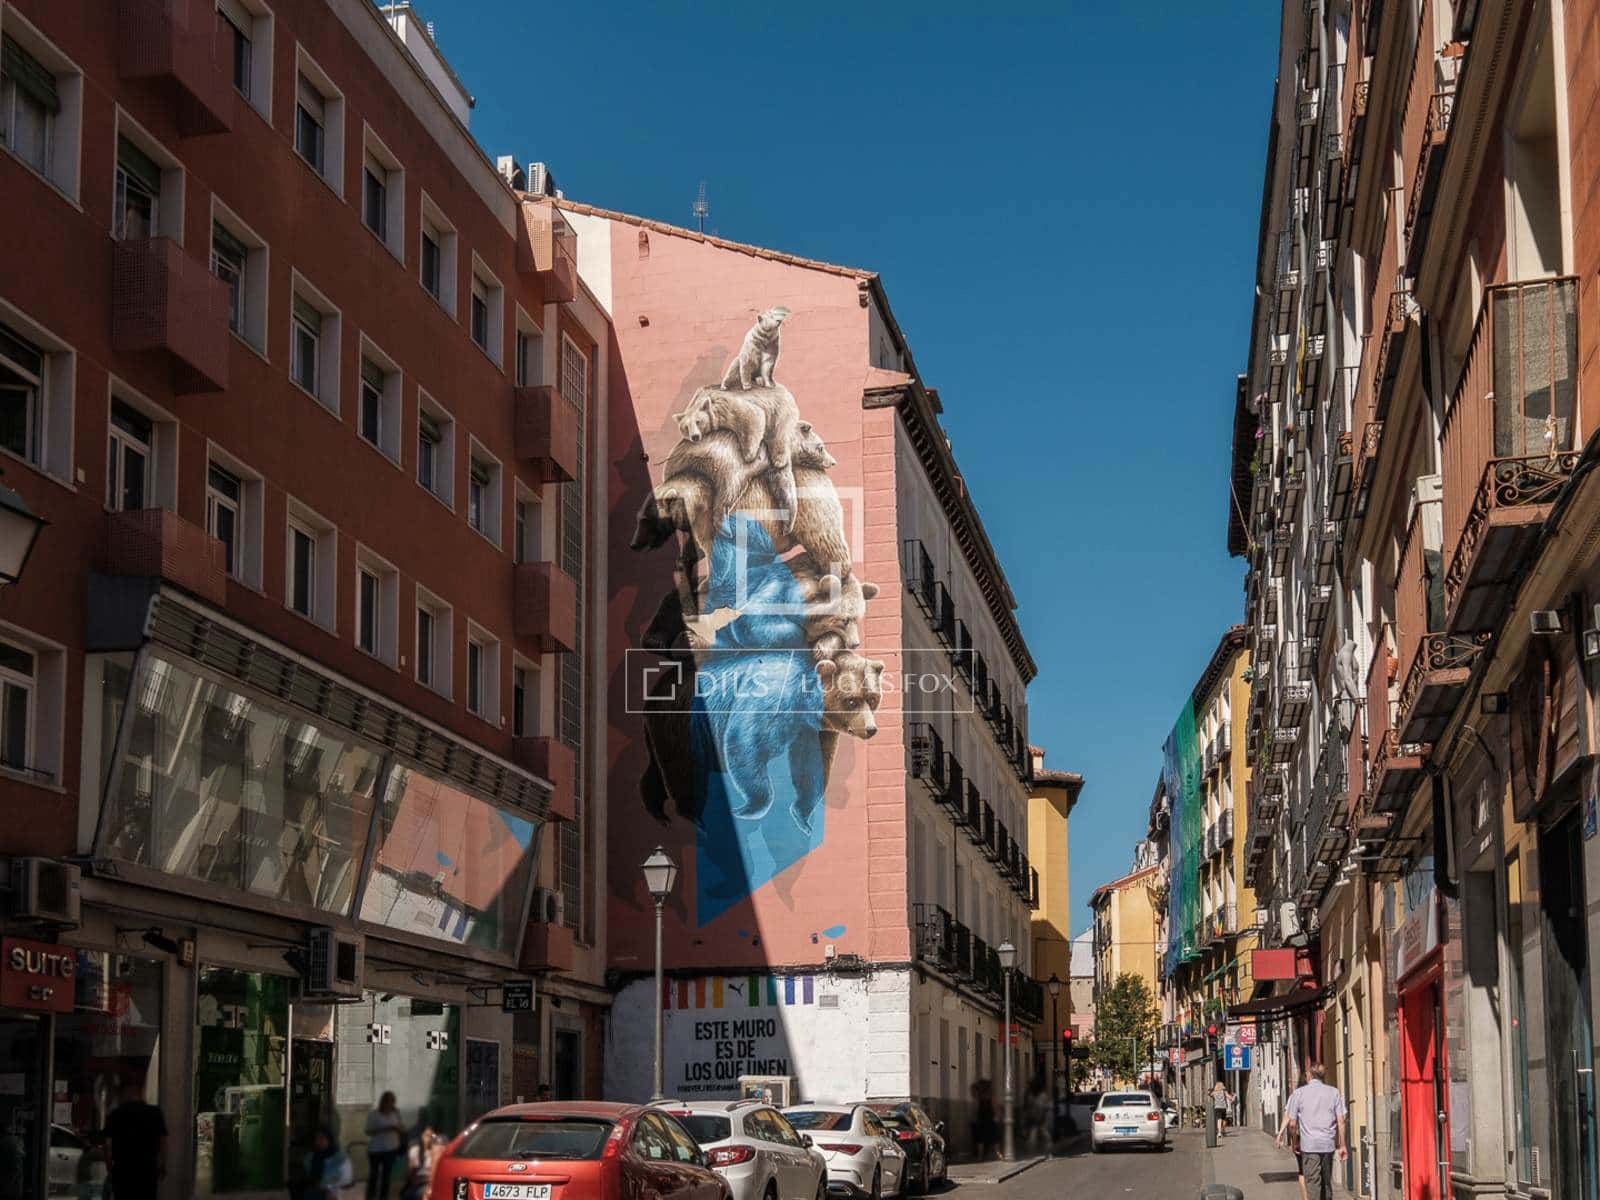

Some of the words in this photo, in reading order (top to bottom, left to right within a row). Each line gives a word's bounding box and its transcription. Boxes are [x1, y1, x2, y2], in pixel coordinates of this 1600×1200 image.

[694, 1021, 730, 1041] ESTE
[733, 1019, 775, 1038] MURO
[716, 1041, 733, 1059] ES
[737, 1040, 755, 1058] DE
[684, 1062, 712, 1082] LOS
[715, 1060, 743, 1080] QUE
[748, 1059, 787, 1076] UNEN
[491, 1185, 520, 1199] 4673
[526, 1186, 548, 1198] FLP
